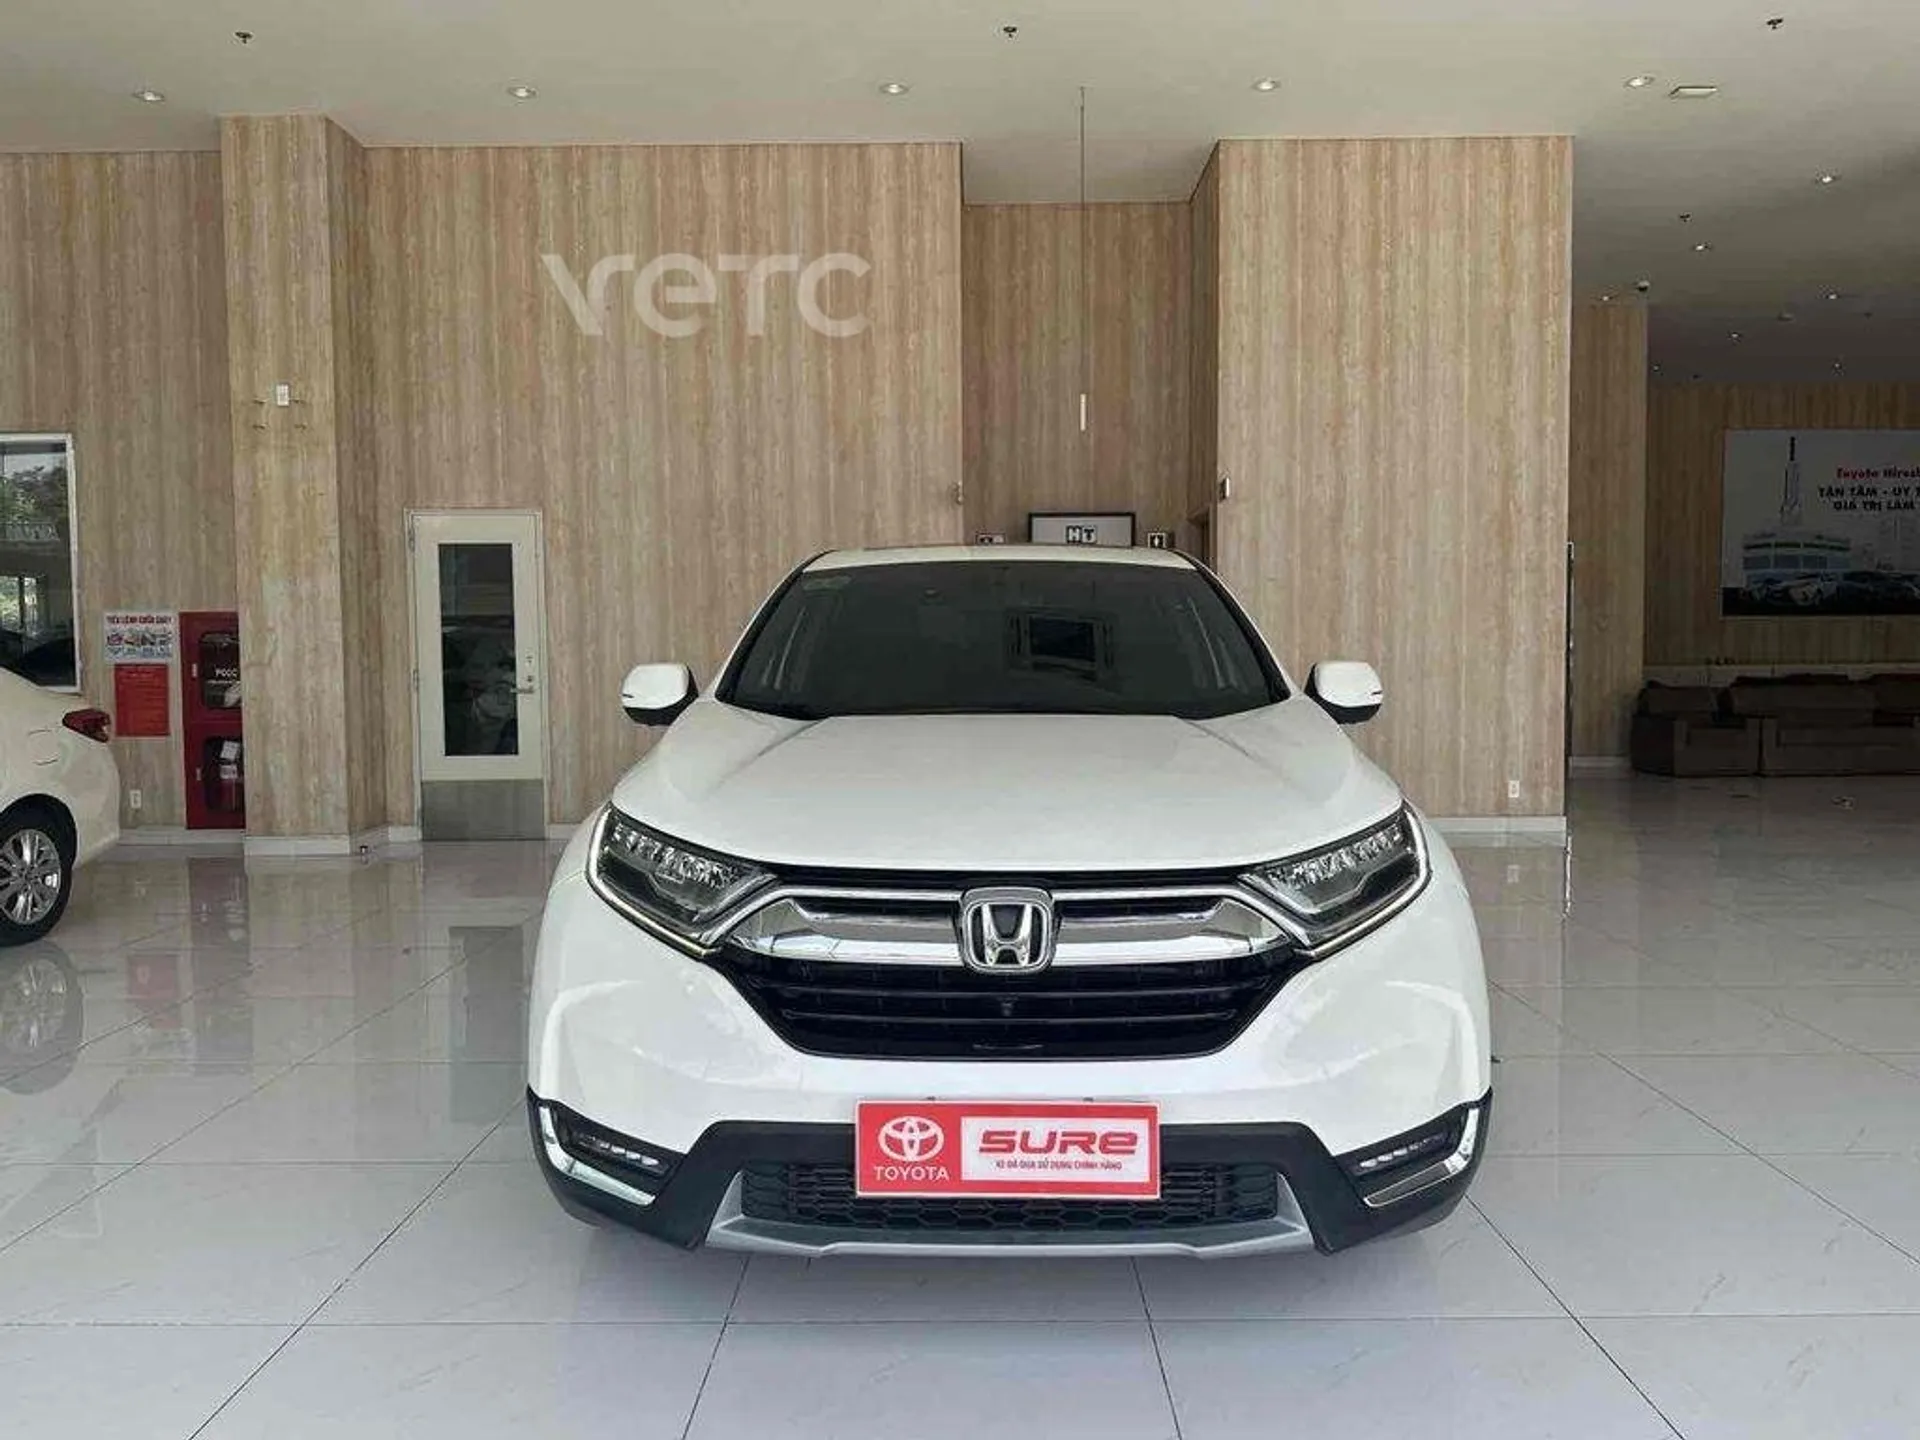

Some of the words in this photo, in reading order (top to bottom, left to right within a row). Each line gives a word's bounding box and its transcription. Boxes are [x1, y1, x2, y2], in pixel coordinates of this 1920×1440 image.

[1837, 467, 1879, 479] Toyota
[1020, 1160, 1035, 1170] QUA
[874, 1165, 950, 1181] TOYOTA
